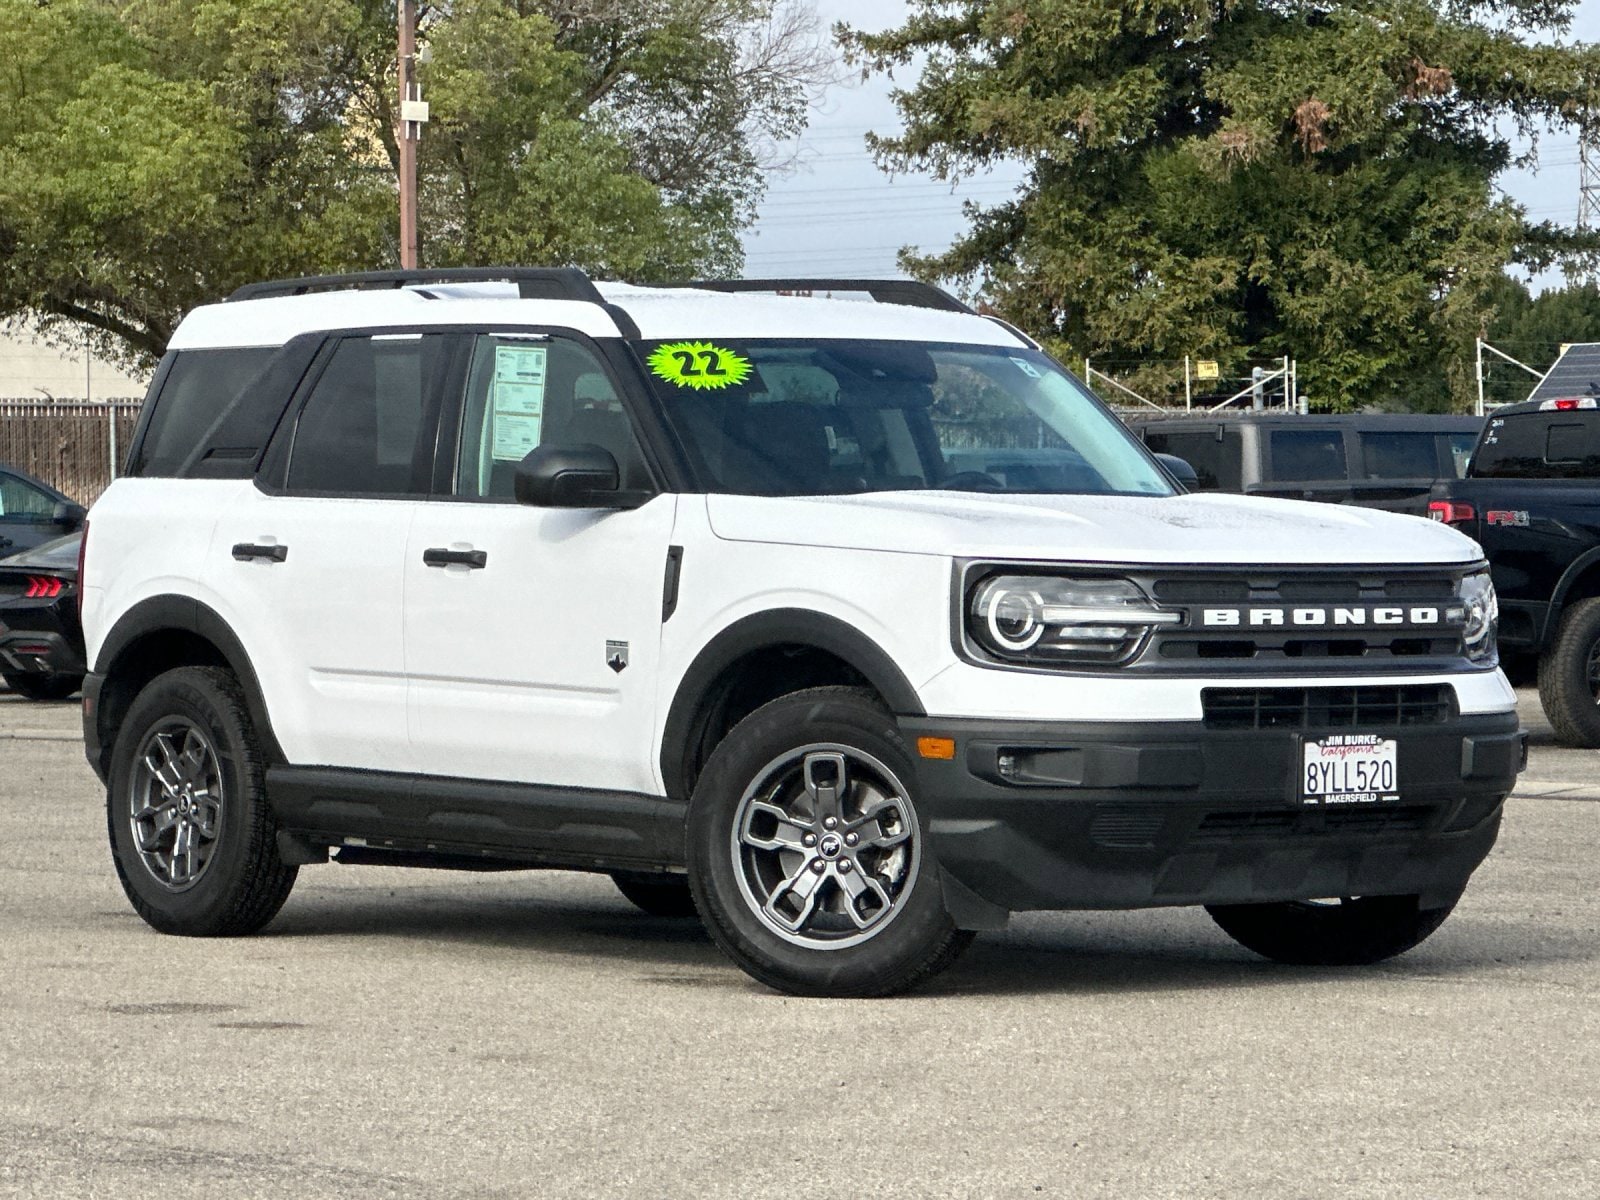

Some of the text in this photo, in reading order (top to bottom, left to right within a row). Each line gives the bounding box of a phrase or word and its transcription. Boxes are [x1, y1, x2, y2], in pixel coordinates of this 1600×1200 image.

[671, 350, 727, 377] 22
[1203, 607, 1439, 626] BRONCO
[1325, 734, 1377, 746] JIM BURKE
[1320, 745, 1381, 760] California
[1307, 760, 1393, 793] 8YLL520
[1325, 792, 1377, 804] BAKERSFIELD
